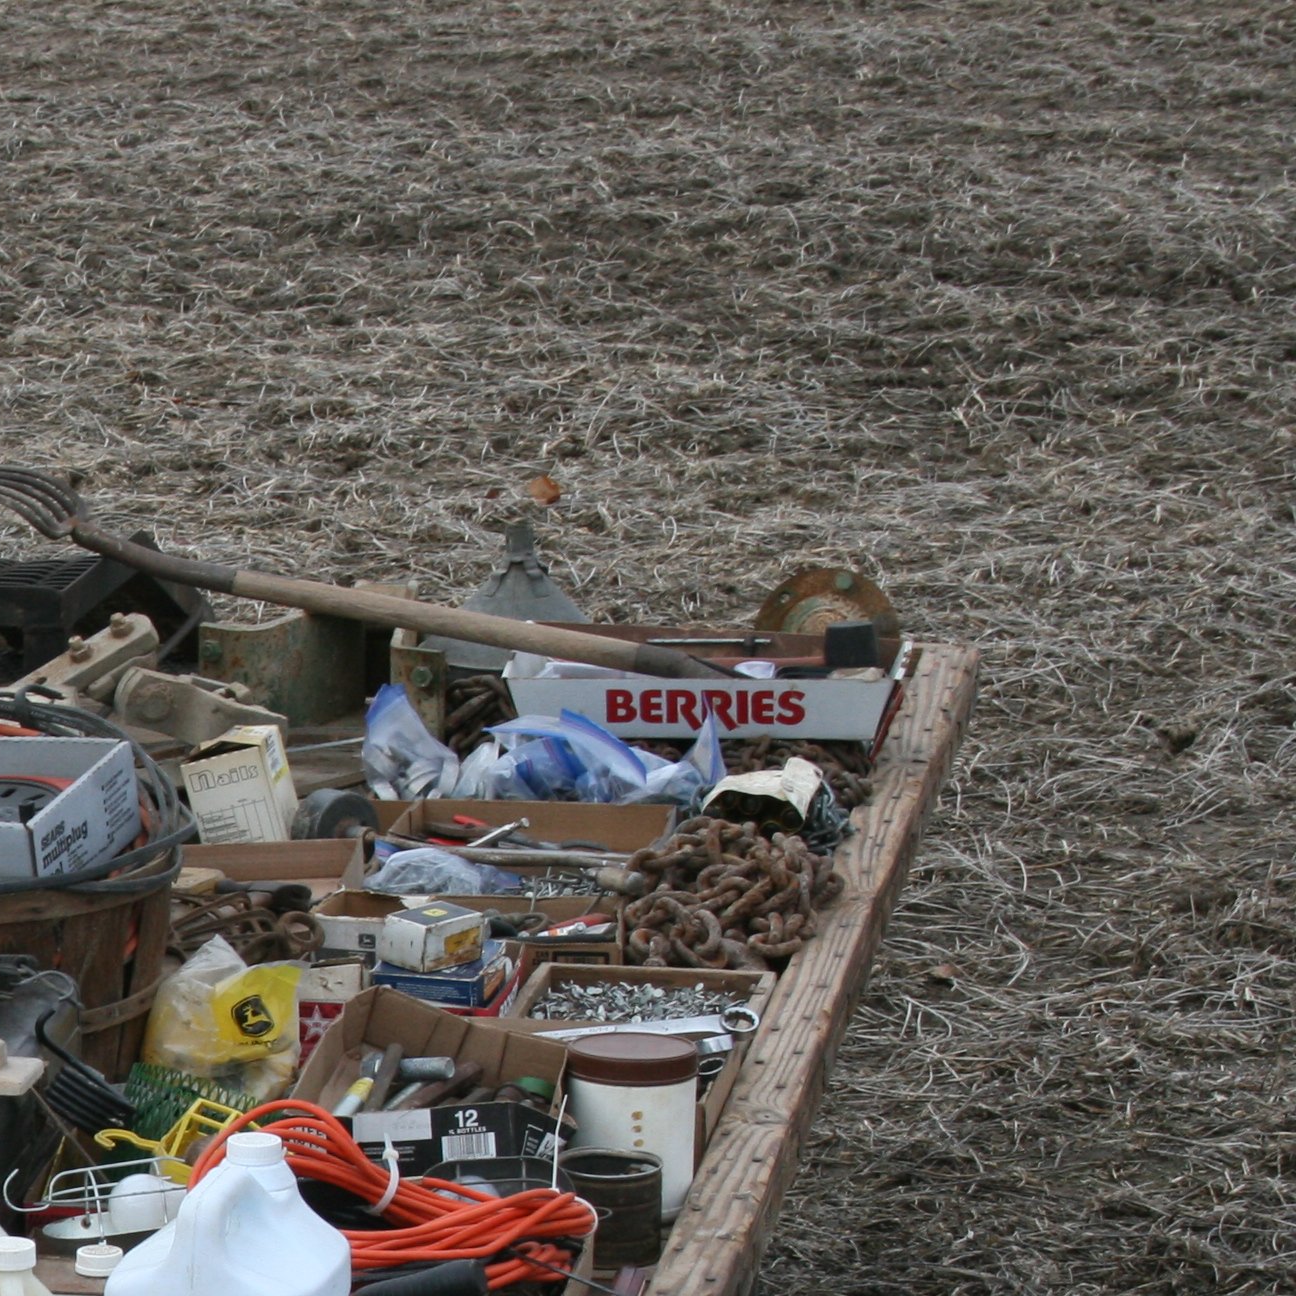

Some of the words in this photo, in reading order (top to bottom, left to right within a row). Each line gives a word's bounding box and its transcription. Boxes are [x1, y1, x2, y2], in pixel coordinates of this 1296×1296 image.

[605, 689, 806, 732] BERRIES
[40, 820, 66, 852] SEARS
[42, 820, 88, 870] multiplug
[454, 1109, 479, 1128] 12
